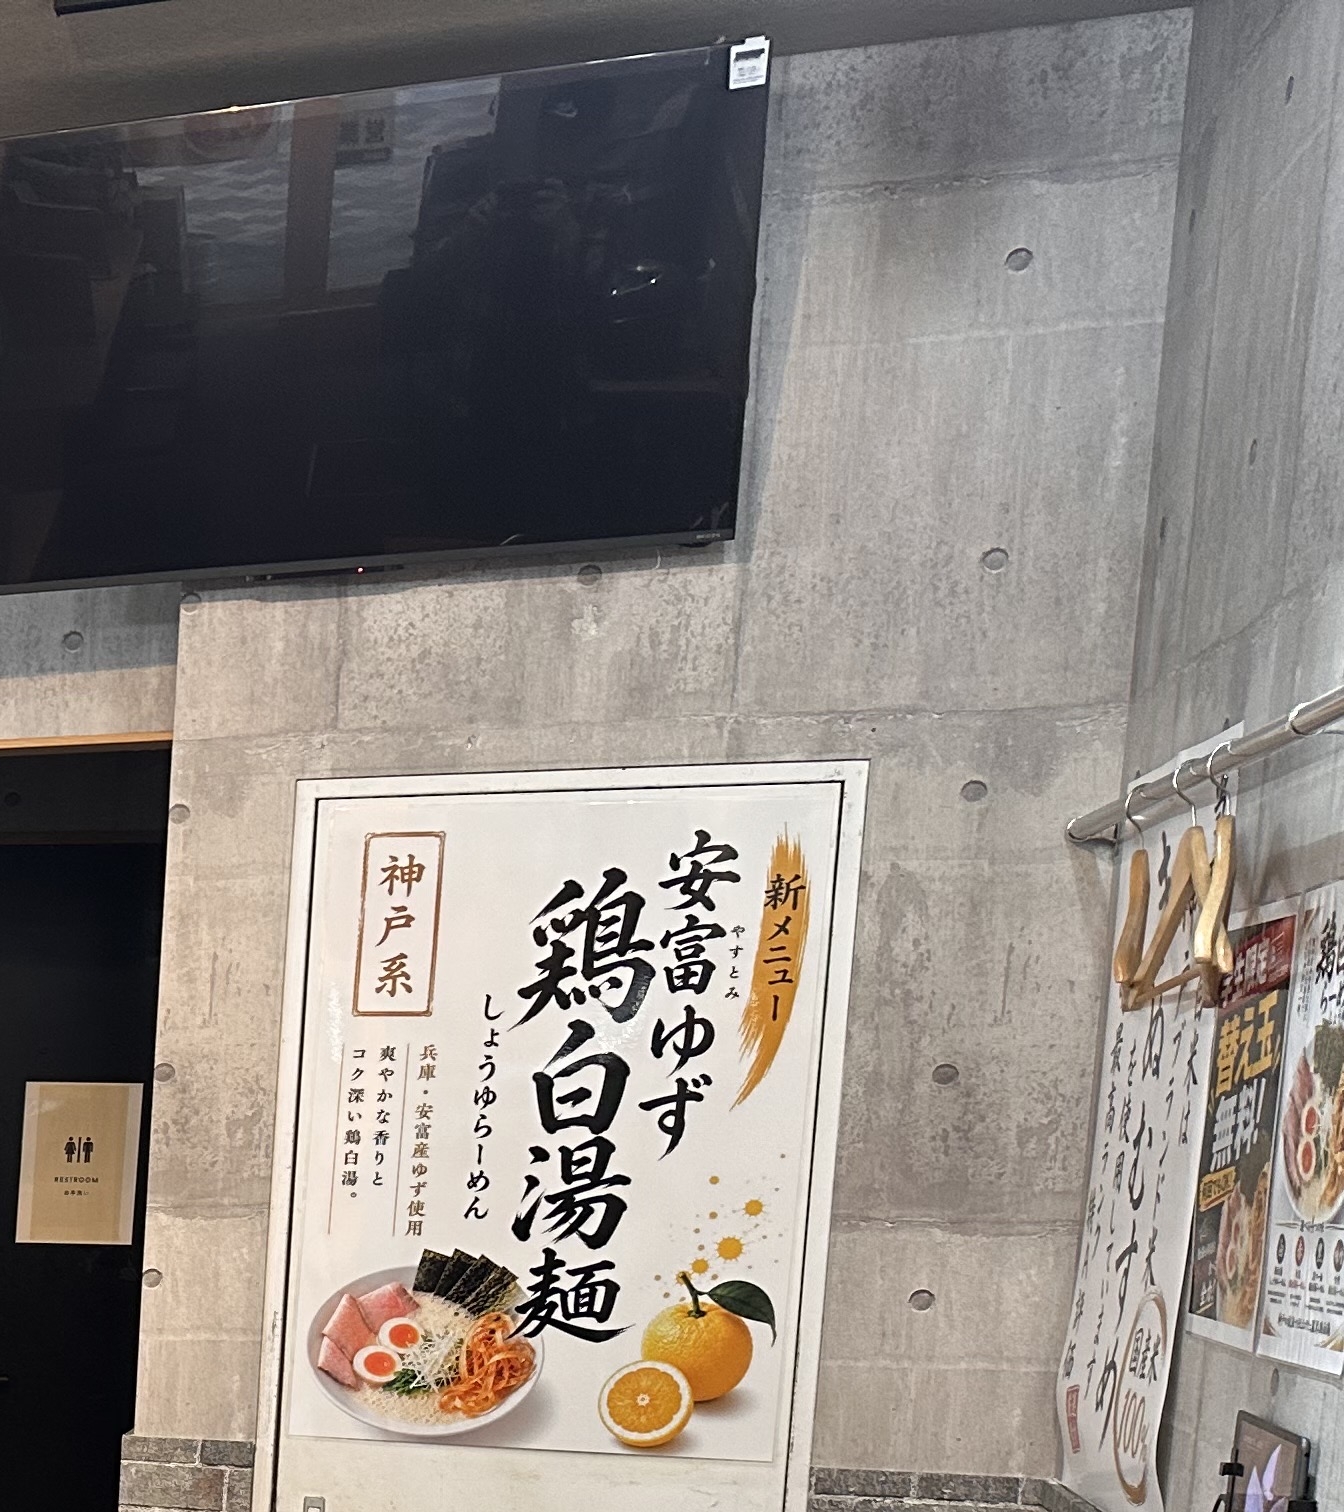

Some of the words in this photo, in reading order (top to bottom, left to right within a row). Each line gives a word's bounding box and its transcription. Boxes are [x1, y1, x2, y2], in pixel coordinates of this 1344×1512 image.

[375, 853, 426, 997] 神戸系
[638, 828, 742, 1161] 安富ゆず
[724, 925, 746, 1001] やすとみ
[763, 873, 808, 1022] 新メニュー
[372, 1046, 397, 1187] 爽やかな香りと
[464, 993, 505, 1220] しょうゆらーめん
[506, 866, 657, 1345] 鶏白湯麺
[1215, 989, 1279, 1097] 替え玉
[54, 1176, 99, 1184] RESTROOM
[341, 1047, 367, 1199] コク深い鶏白湯。
[405, 1044, 438, 1237] 兵庫・安富産ゆず使用
